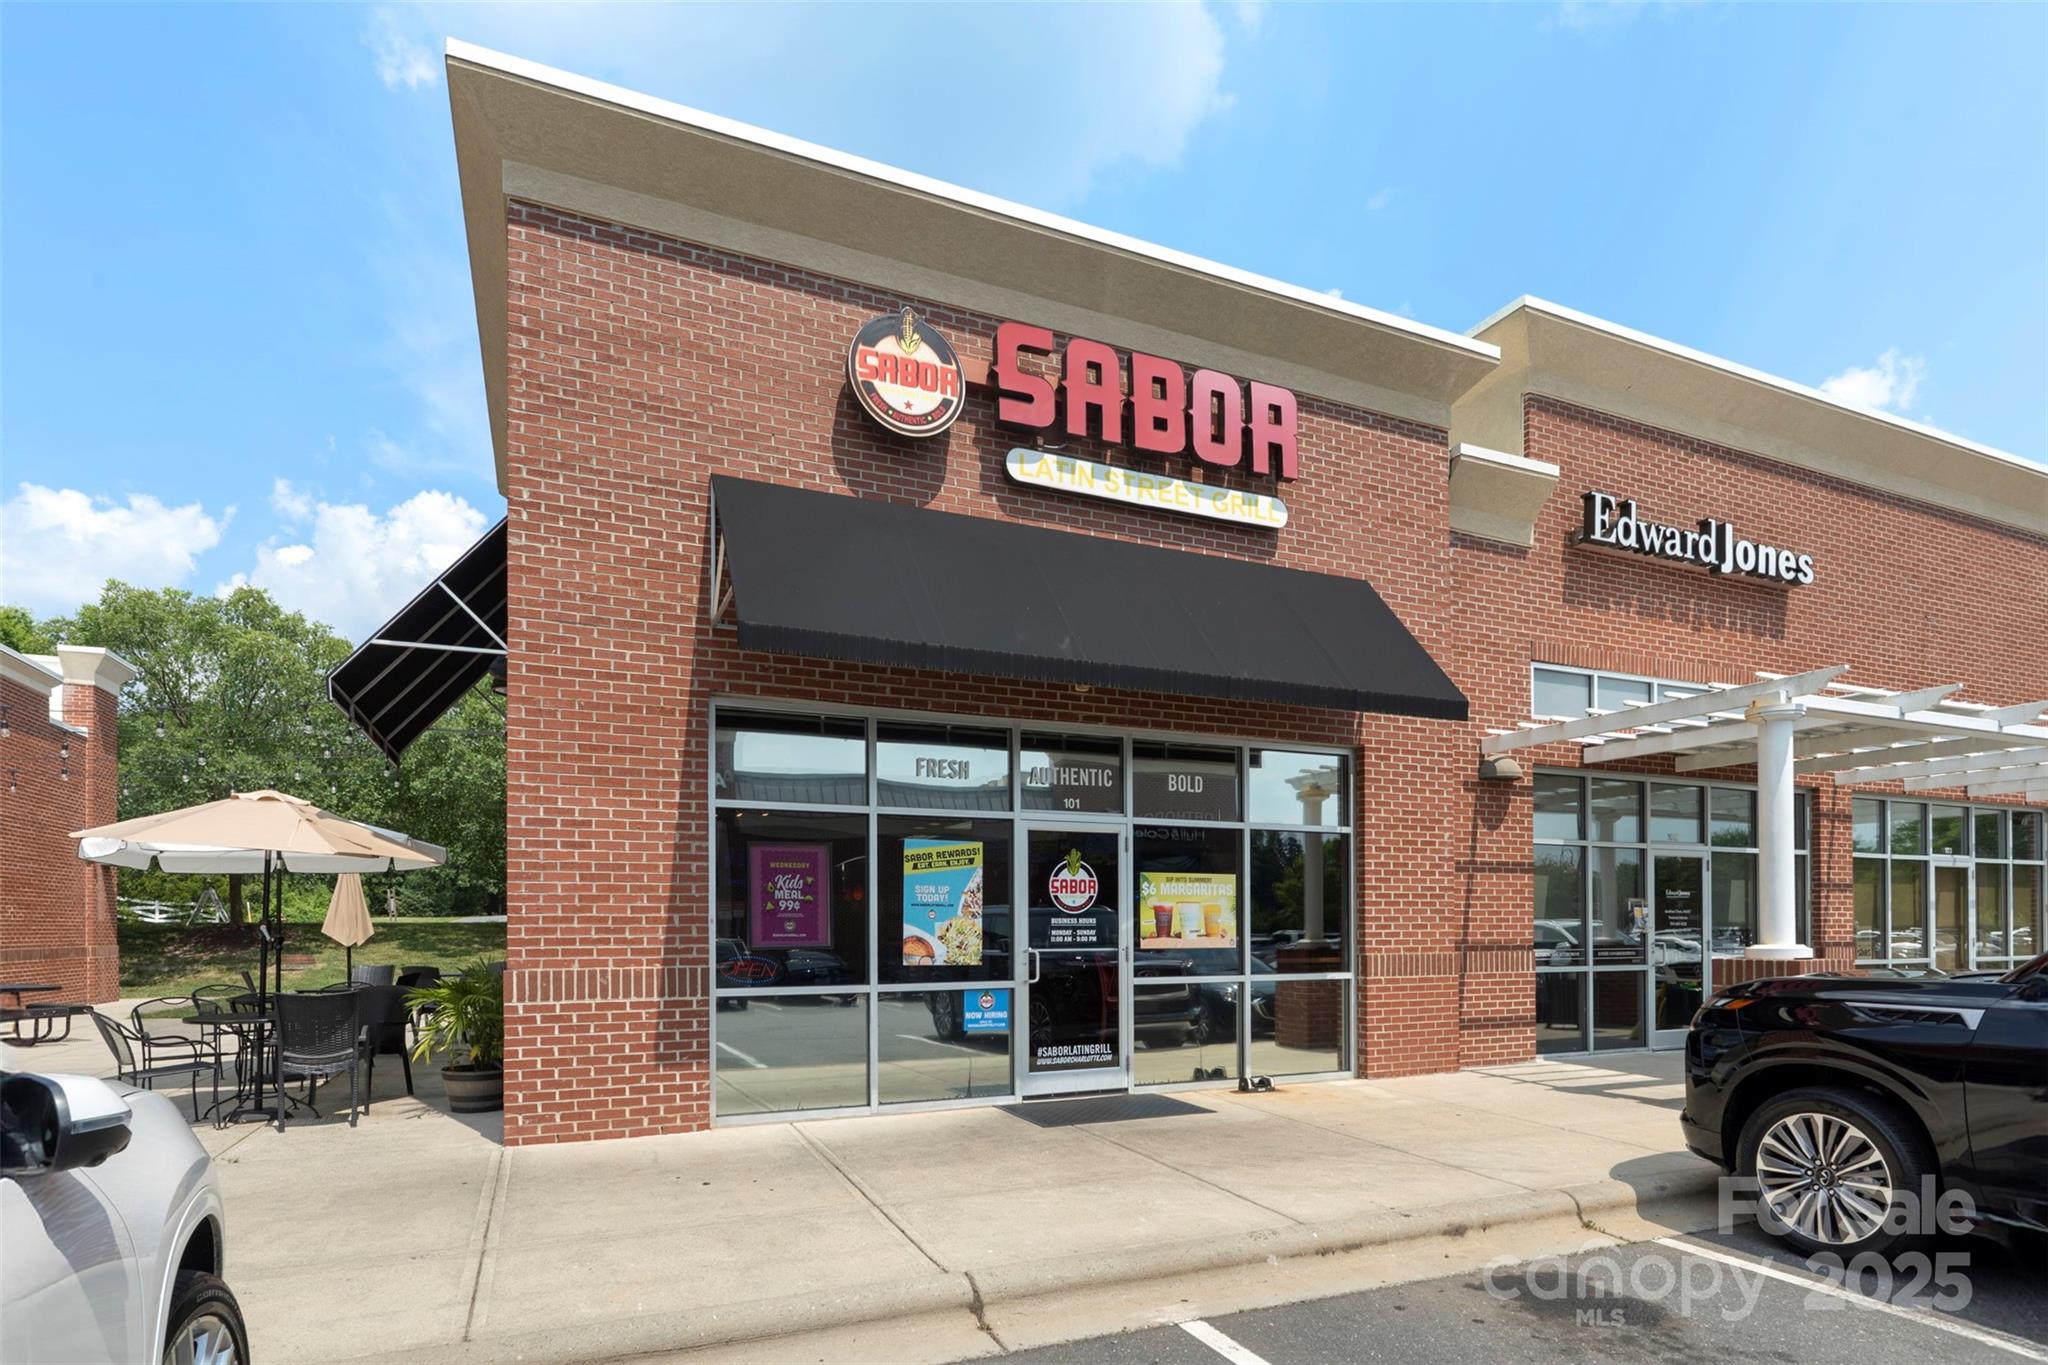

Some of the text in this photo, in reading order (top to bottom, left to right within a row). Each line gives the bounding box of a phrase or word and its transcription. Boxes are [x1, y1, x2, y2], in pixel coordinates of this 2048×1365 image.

[857, 347, 959, 398] SABOR
[994, 322, 1298, 482] SABOR
[1017, 452, 1280, 523] LATIN STREET GRILL
[1591, 491, 1815, 585] Edward Jones
[915, 757, 970, 780] FRESH
[1029, 766, 1113, 788] AUTHENTIC
[1168, 774, 1203, 793] BOLD
[1063, 798, 1080, 809] 101
[904, 847, 981, 863] SABOR REWARDS!
[774, 874, 803, 890] Kids
[915, 885, 949, 894] SIGN UP
[1051, 879, 1096, 894] SABOR
[1142, 881, 1233, 896] $6 MARGARITAS
[774, 890, 804, 900] MEAL
[915, 893, 949, 902] TODAY!
[779, 900, 800, 911] 99¢
[1037, 1043, 1112, 1057] #SABORLATINGRILL
